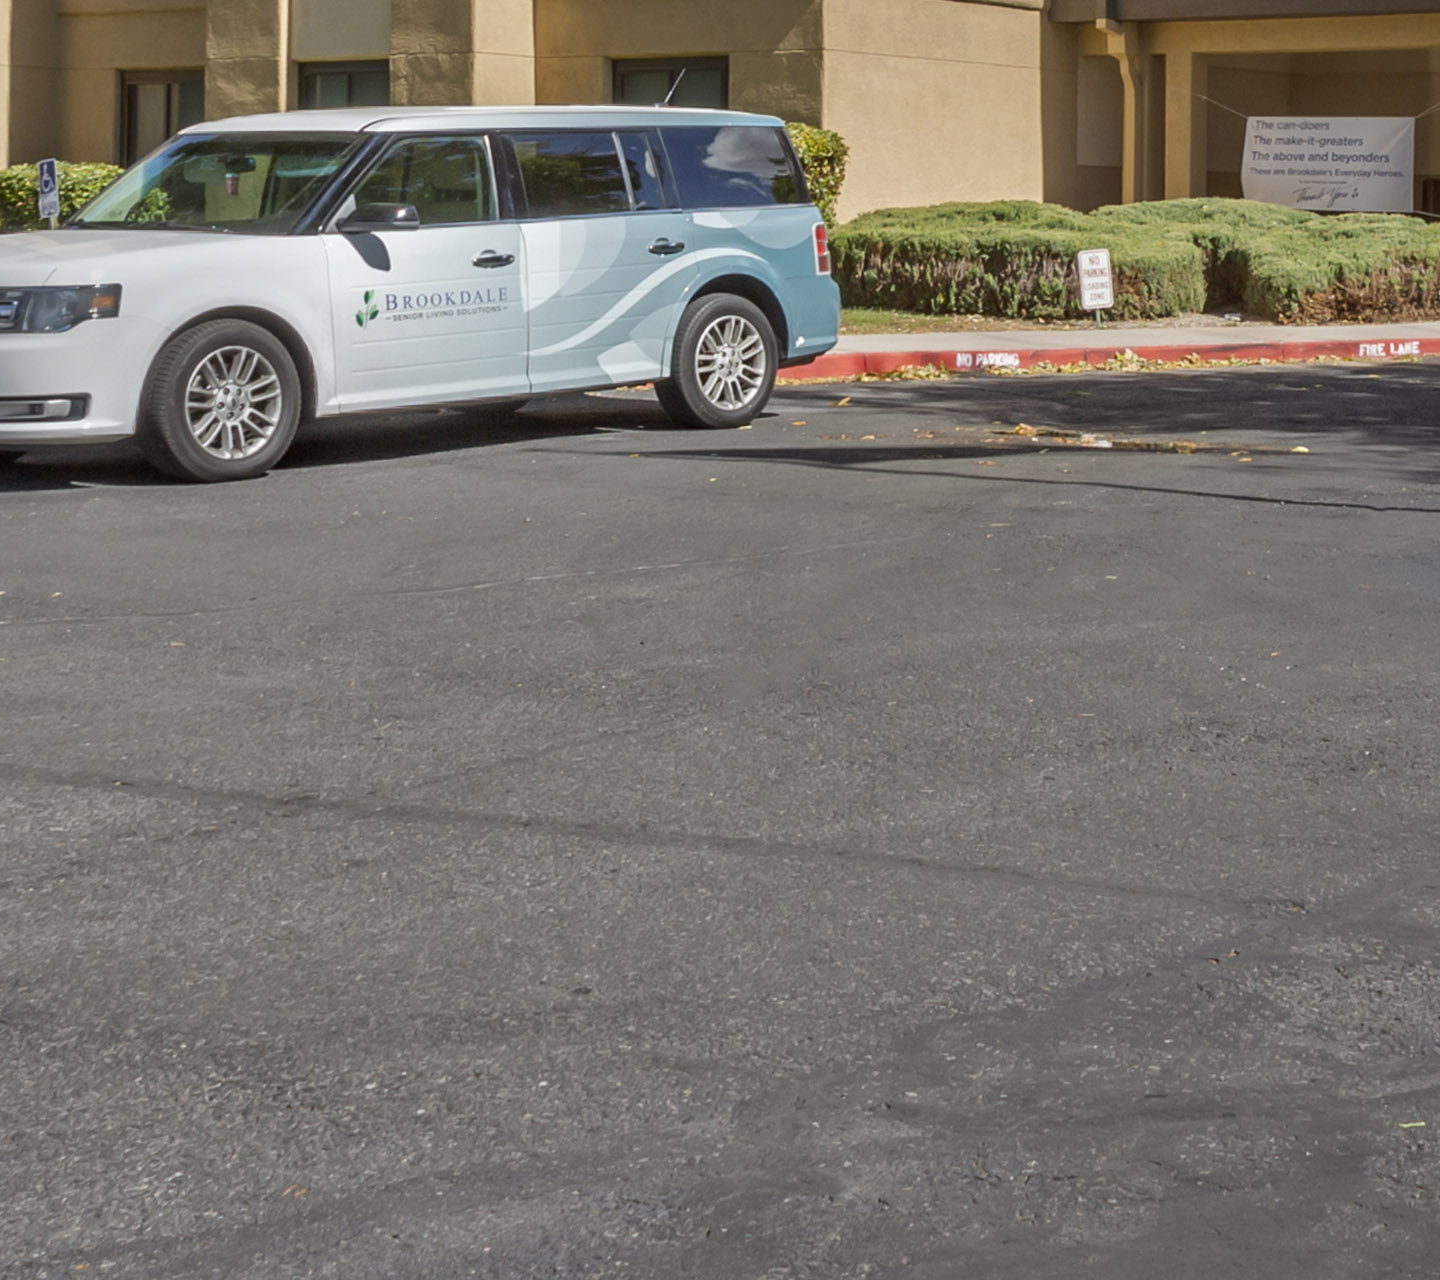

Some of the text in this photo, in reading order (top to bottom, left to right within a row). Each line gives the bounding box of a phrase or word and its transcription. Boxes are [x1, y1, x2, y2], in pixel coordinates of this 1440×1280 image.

[1254, 120, 1330, 131] The can-doers
[1252, 135, 1364, 148] The make-it-greaters
[1251, 151, 1390, 164] The above and beyonders
[1334, 168, 1372, 179] Everyday
[385, 287, 509, 311] BROOKDALE
[392, 305, 502, 322] SENIOR LIVING SOLUTIONS
[1358, 340, 1420, 357] FIRE LANE
[956, 351, 973, 368] NO
